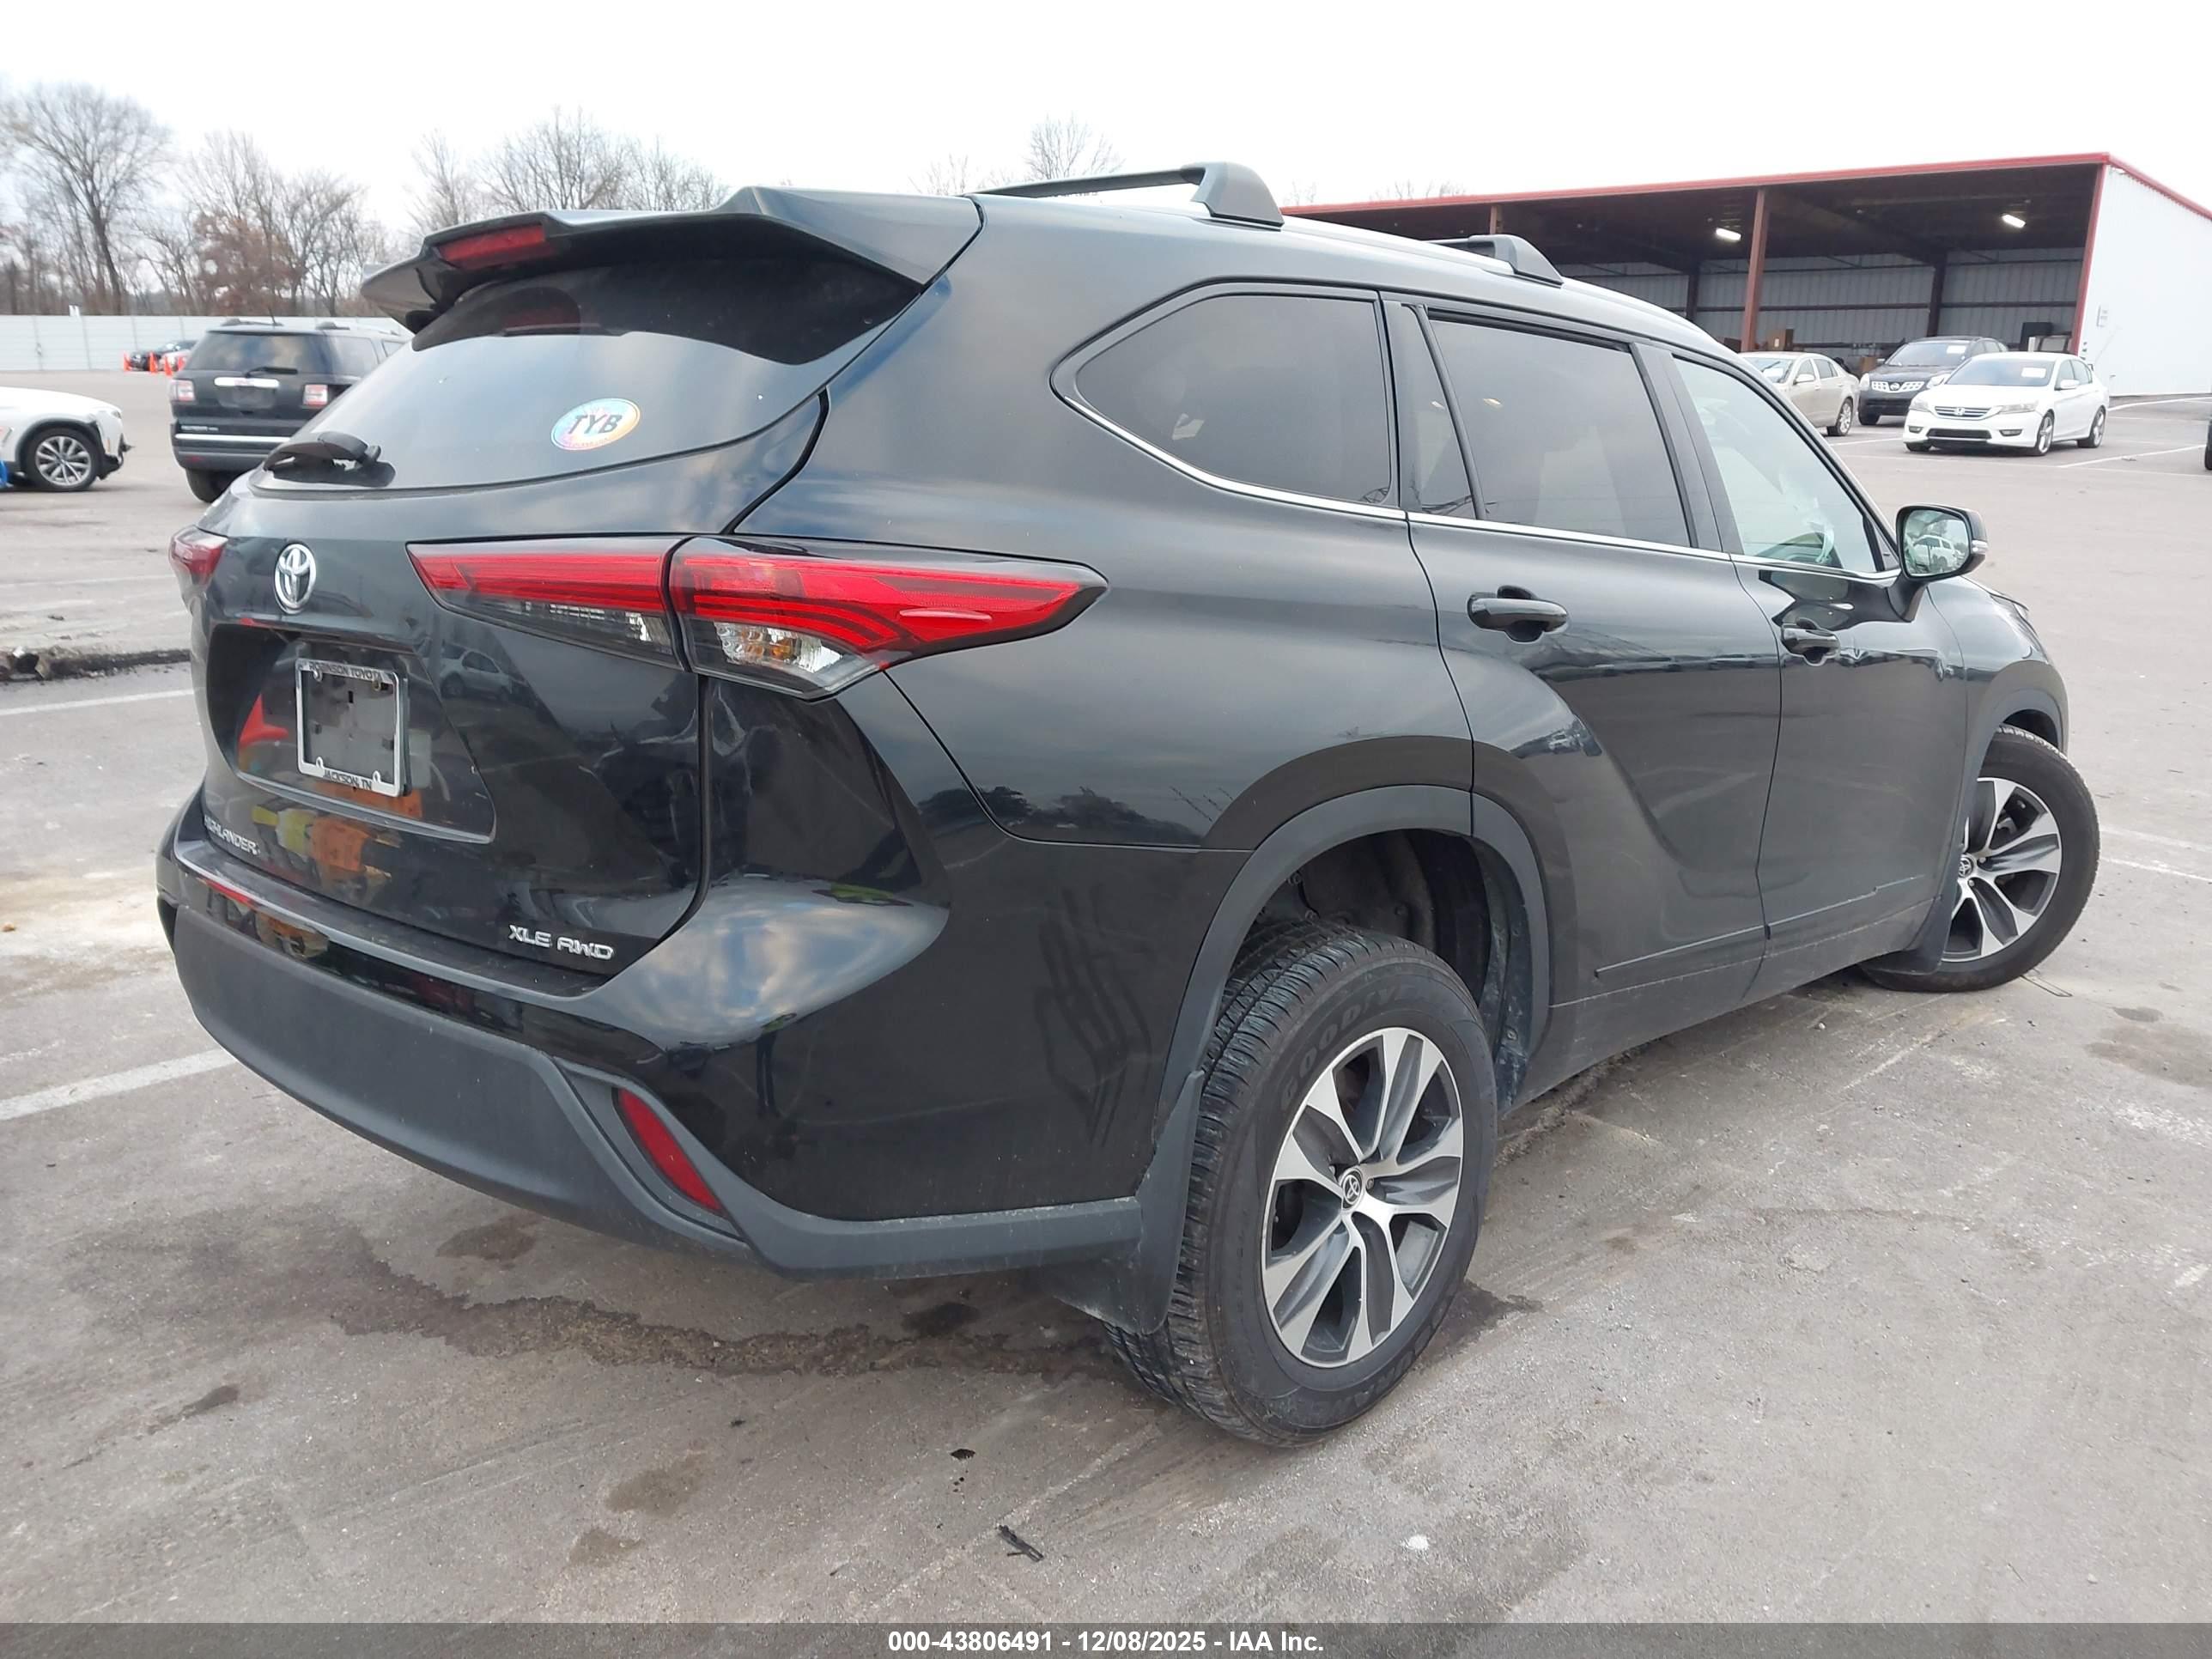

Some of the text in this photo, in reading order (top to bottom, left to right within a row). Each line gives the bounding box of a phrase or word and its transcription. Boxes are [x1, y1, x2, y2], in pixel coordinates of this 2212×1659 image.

[568, 414, 623, 434] TYB
[349, 667, 382, 682] TOYOTA
[362, 779, 373, 790] TN
[508, 924, 615, 960] XLE AWD
